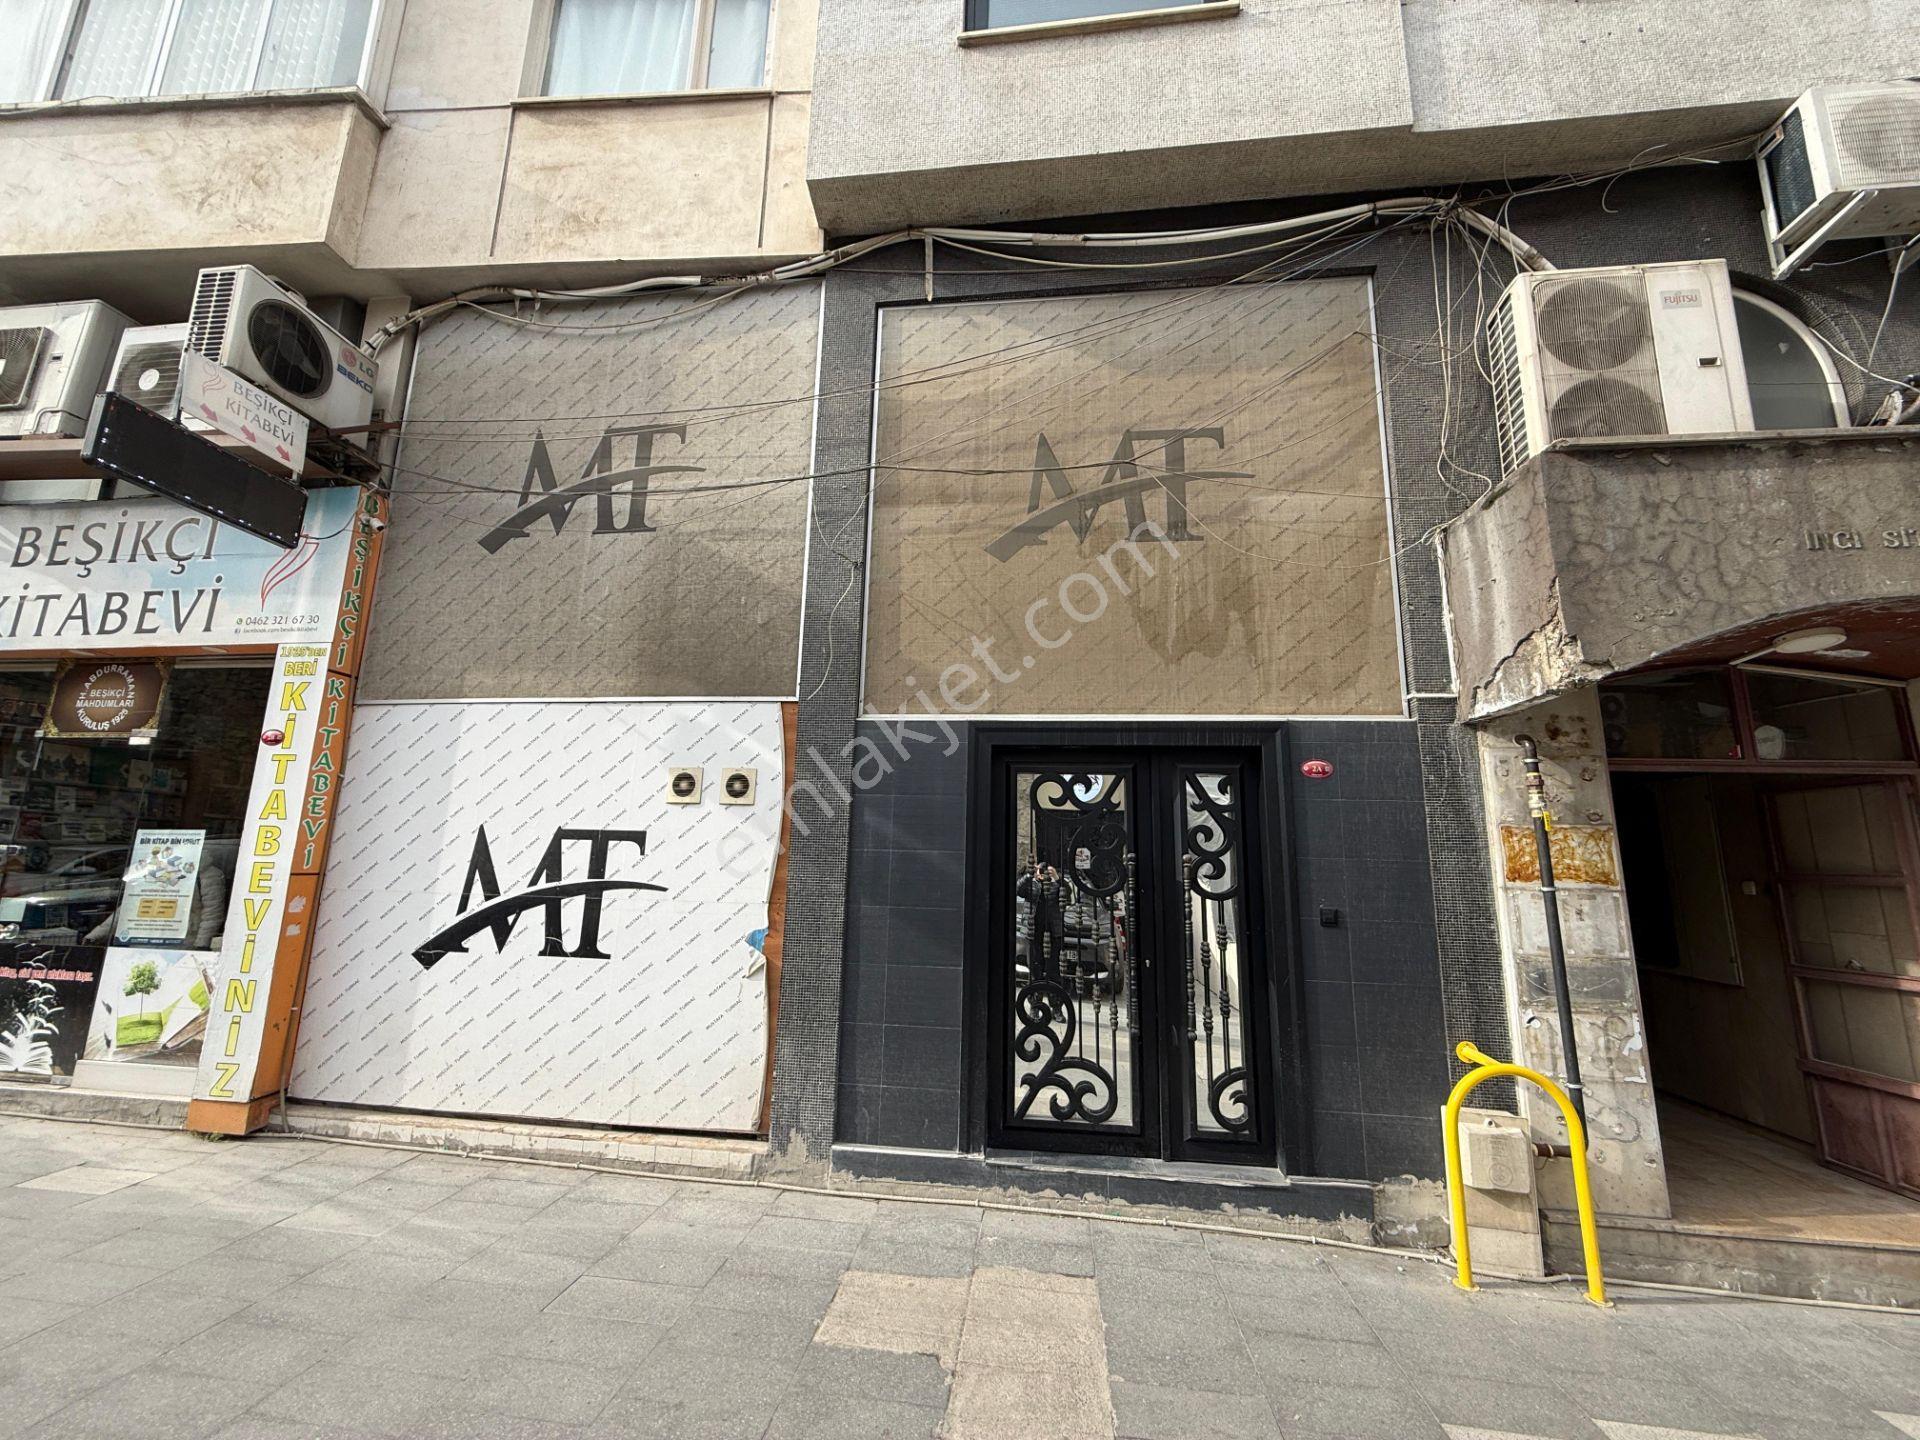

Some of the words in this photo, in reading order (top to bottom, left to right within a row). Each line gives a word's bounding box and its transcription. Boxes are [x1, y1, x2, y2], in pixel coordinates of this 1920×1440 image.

[1663, 294, 1698, 305] FUJITSU
[337, 363, 374, 394] BEKO
[233, 380, 294, 427] BEŞİKÇİ
[225, 397, 295, 448] KİTABEVİ
[245, 617, 269, 626] 0462
[271, 615, 288, 625] 321
[291, 615, 305, 624] 67
[307, 614, 320, 624] 30
[283, 658, 319, 676] BERİ
[75, 699, 135, 708] MAHDUMLARI
[302, 676, 348, 869] KİTABEVİ
[209, 681, 312, 1098] KİTABEVİNİZ
